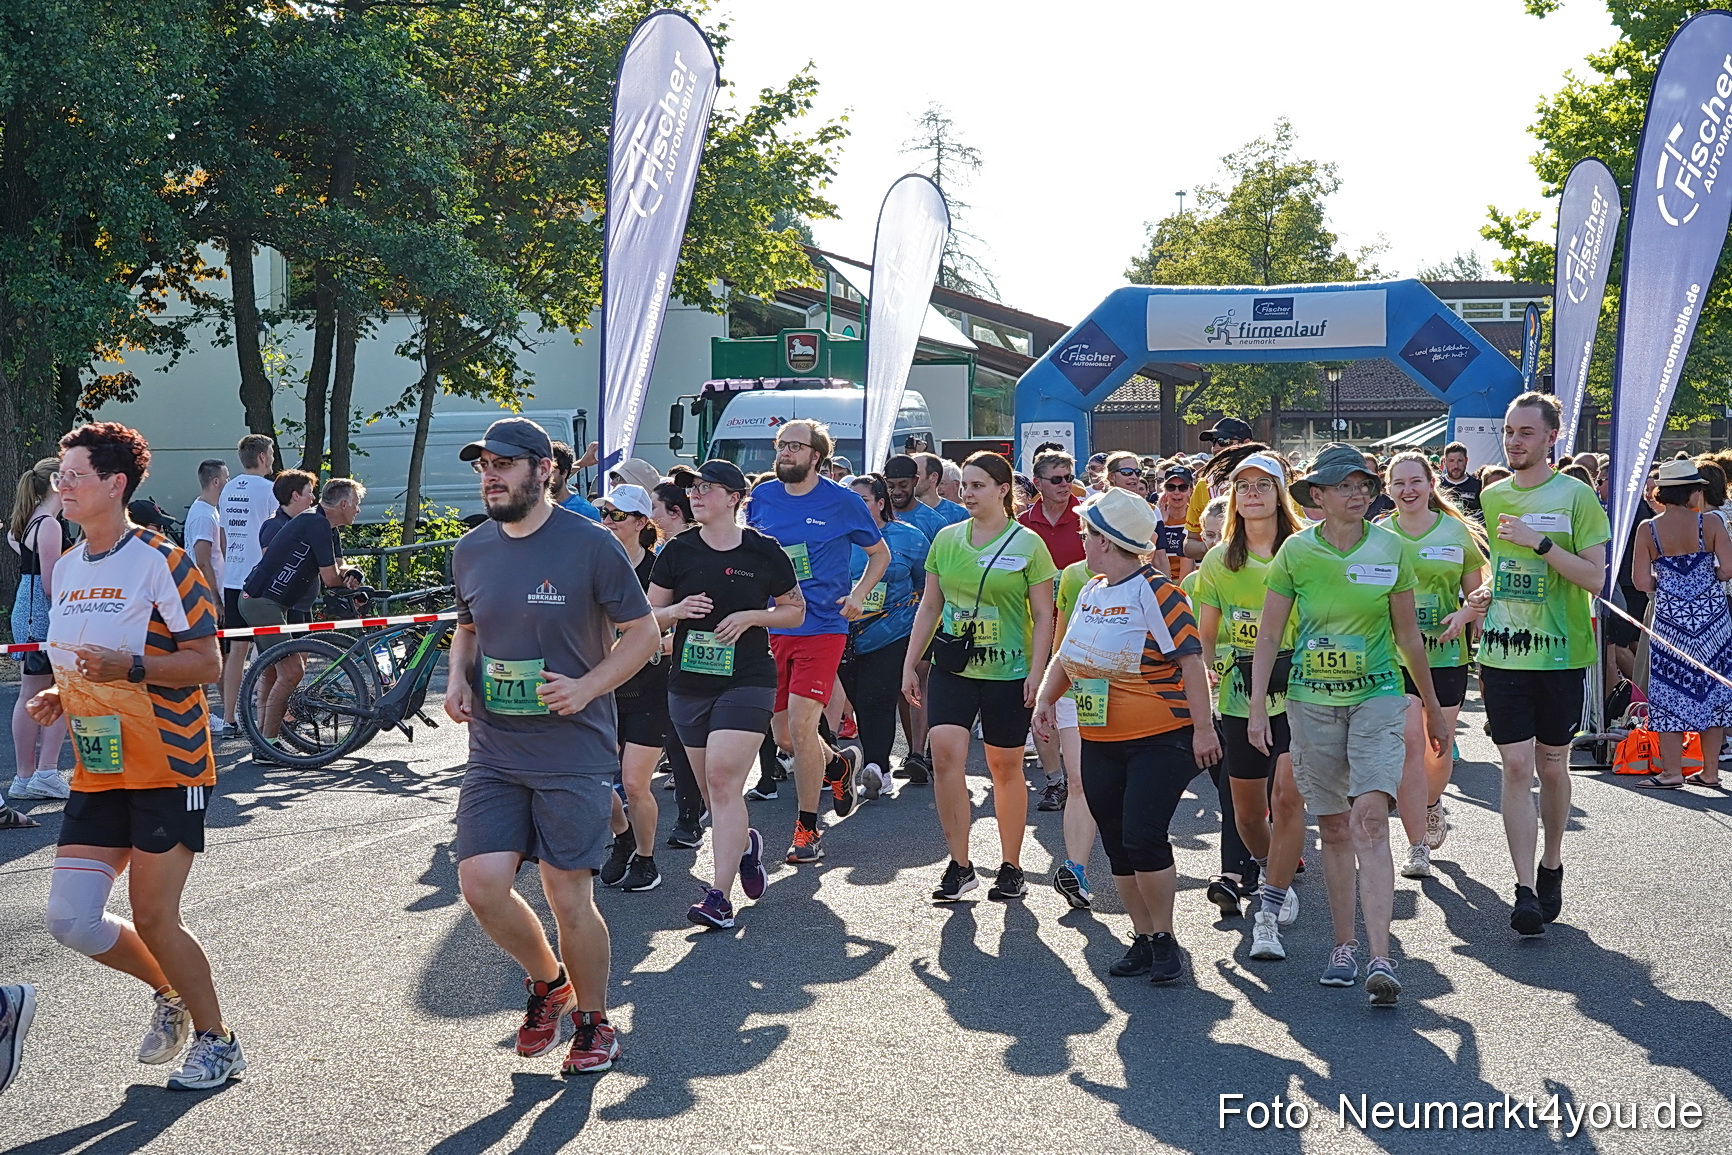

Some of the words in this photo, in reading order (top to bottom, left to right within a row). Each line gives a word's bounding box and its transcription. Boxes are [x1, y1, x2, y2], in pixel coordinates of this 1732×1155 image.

[641, 50, 688, 192] Fischer
[665, 70, 698, 185] AUTOMOBILE
[1674, 53, 1732, 200] Fischer
[1703, 100, 1732, 194] AUTOMO
[1574, 184, 1603, 285] Fischer
[1589, 199, 1609, 280] AUTOMOBILE
[1239, 320, 1327, 338] firmenlauf
[1069, 350, 1116, 362] Fischer
[1626, 282, 1700, 492] www.fischer-automobile.de
[726, 416, 767, 427] abavent
[734, 569, 755, 578] ECOVIS
[1505, 573, 1532, 589] 189
[68, 587, 128, 602] KLEBL
[1537, 577, 1545, 598] 2022
[527, 593, 566, 602] BURKHARDT
[62, 602, 126, 616] DYNAMICS
[1236, 637, 1255, 645] Bergler
[689, 645, 726, 661] 1937
[1317, 651, 1347, 668] 151
[1311, 667, 1332, 675] Borchert
[1355, 654, 1363, 676] 2022
[494, 678, 526, 698] 771
[110, 738, 120, 765] 2022
